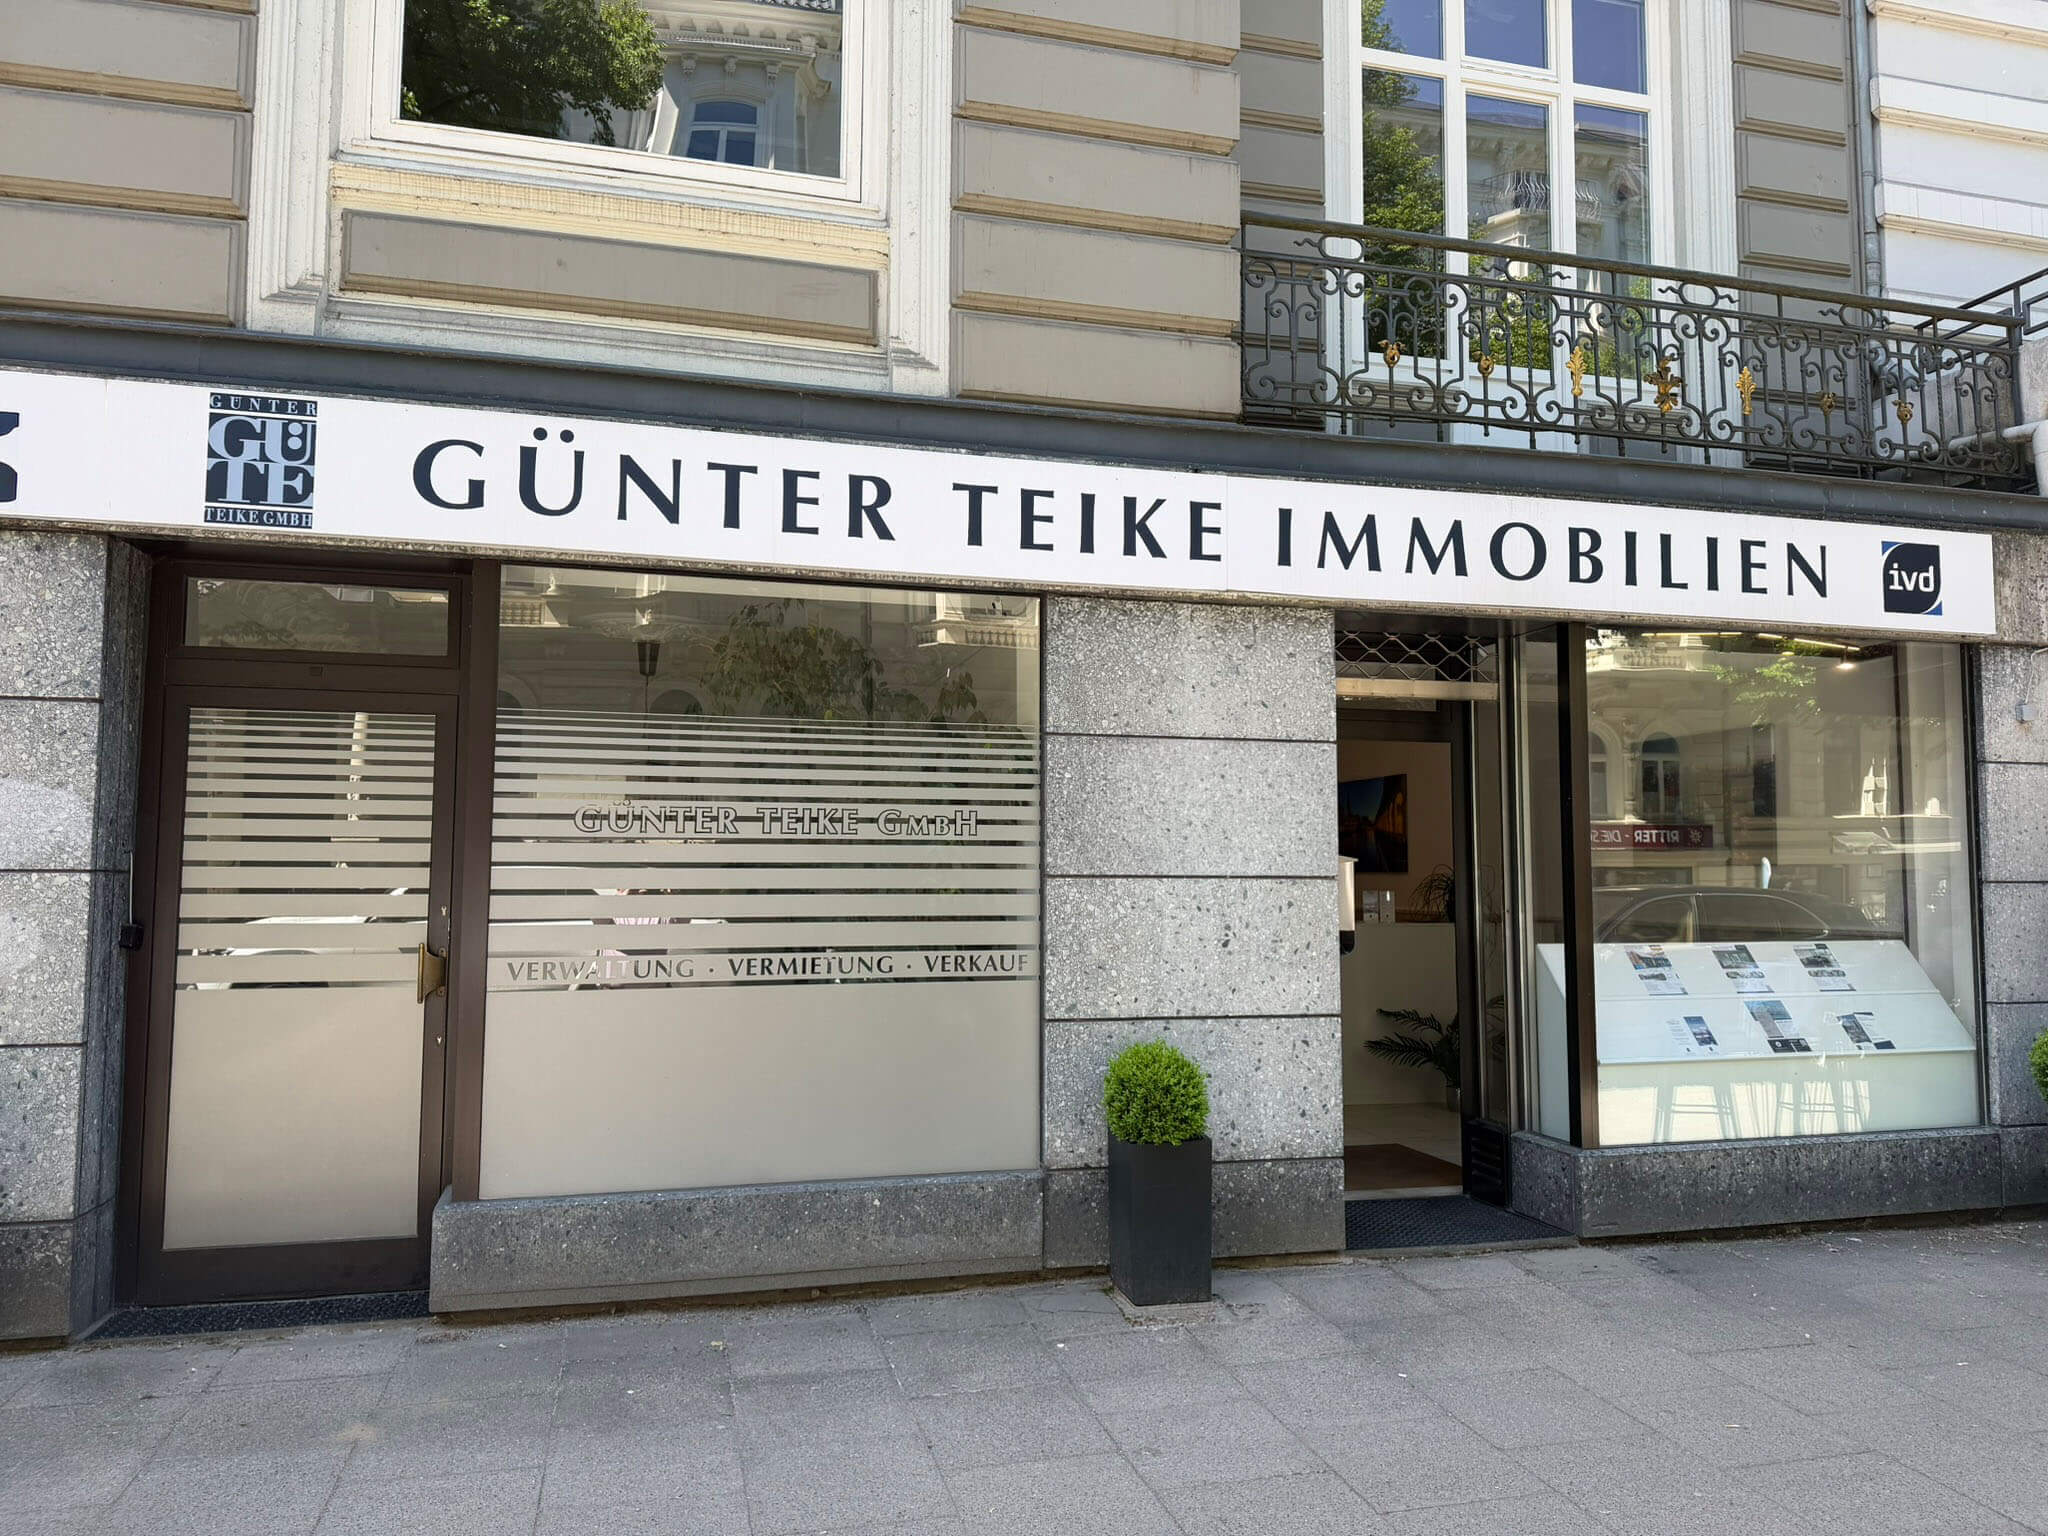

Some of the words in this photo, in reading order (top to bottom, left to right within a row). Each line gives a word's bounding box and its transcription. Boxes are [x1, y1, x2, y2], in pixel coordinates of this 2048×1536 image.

[209, 394, 316, 416] GÜNTER
[206, 507, 259, 524] TEIKE
[263, 511, 313, 527] GMBH
[413, 428, 894, 540] GÜNTER
[953, 483, 1221, 561] TEIKE
[1278, 508, 1826, 597] IMMOBILIEN
[1889, 562, 1935, 592] ivd
[573, 799, 740, 834] GÜNTER
[757, 807, 859, 836] TEIKE
[507, 958, 694, 981] VERWALTUNG
[728, 954, 894, 977] VERMIETUNG
[923, 953, 1029, 973] VERKAUF
